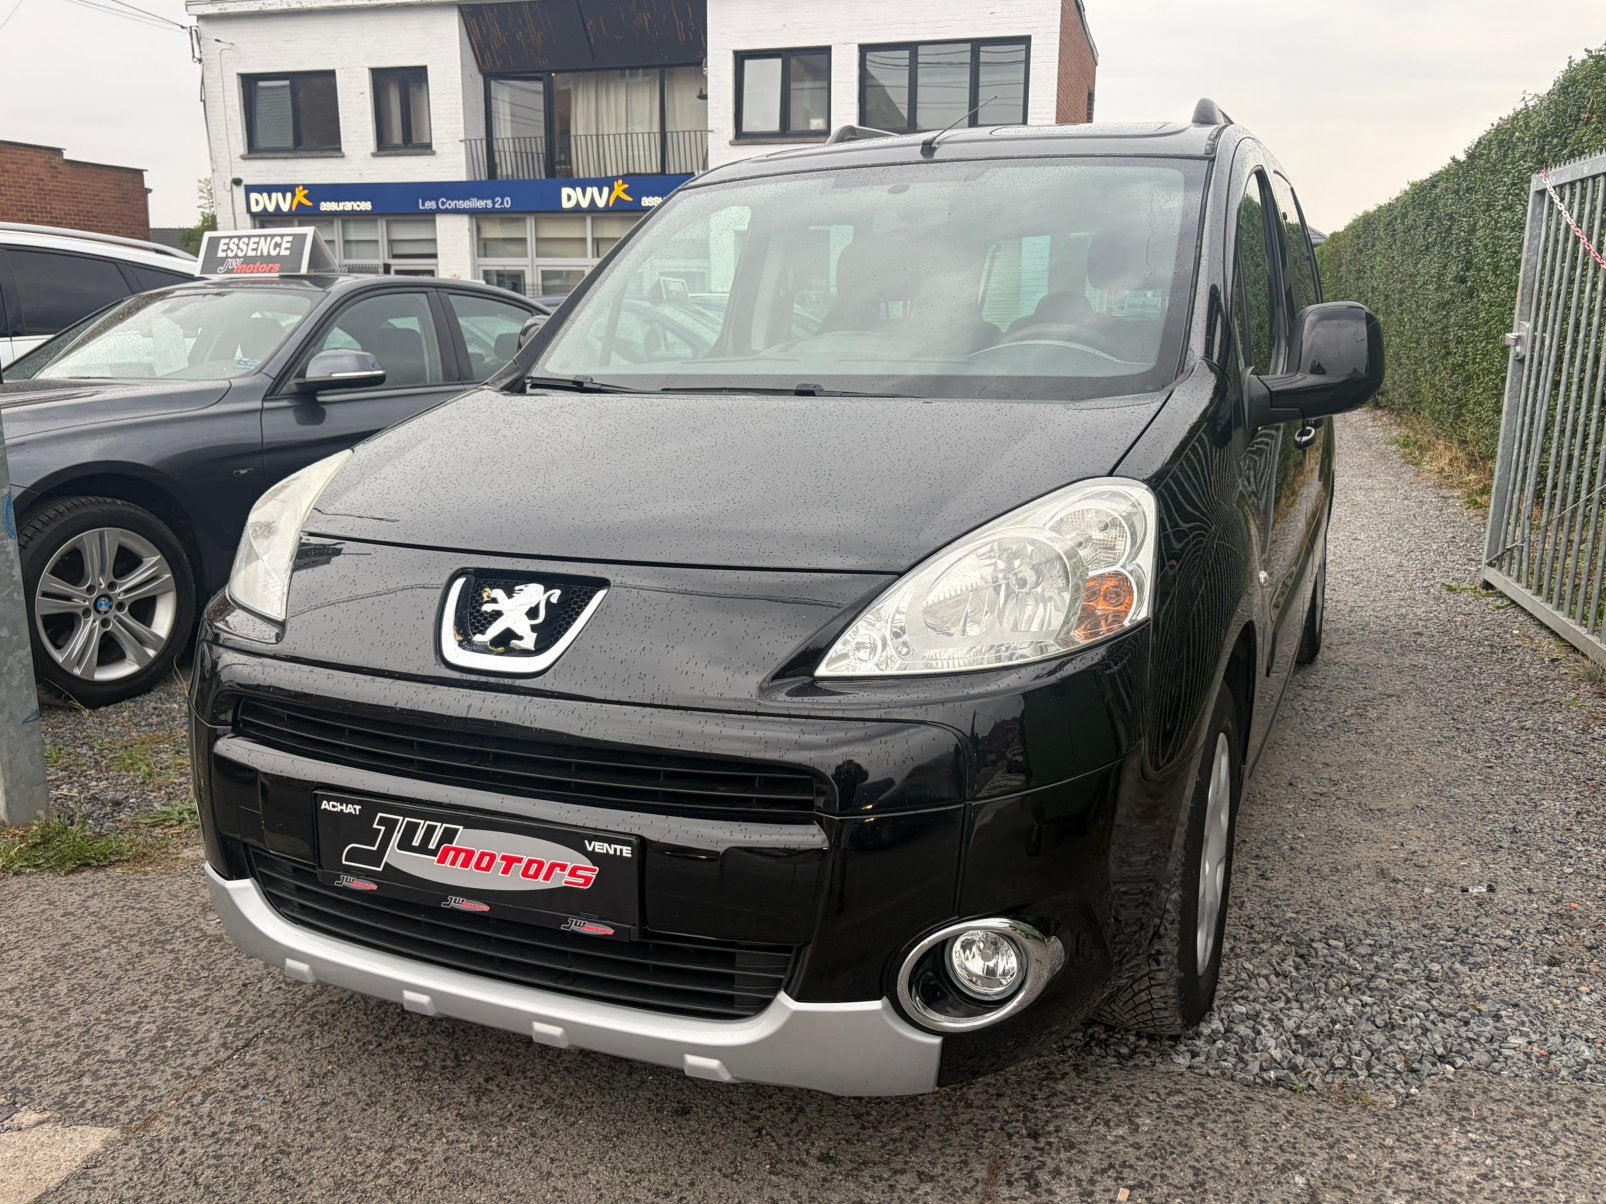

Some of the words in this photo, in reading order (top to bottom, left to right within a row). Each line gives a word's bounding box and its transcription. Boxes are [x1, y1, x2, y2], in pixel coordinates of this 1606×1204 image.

[249, 192, 292, 213] DVV
[319, 201, 372, 211] assurances
[418, 198, 437, 209] Les
[438, 197, 493, 209] Conseillers
[494, 197, 512, 208] 2.0
[561, 186, 610, 209] DVV
[217, 236, 293, 258] ESSENCE
[233, 261, 281, 274] motors
[320, 800, 362, 815] ACHAT
[342, 812, 464, 872] JW
[584, 839, 632, 858] VENTE
